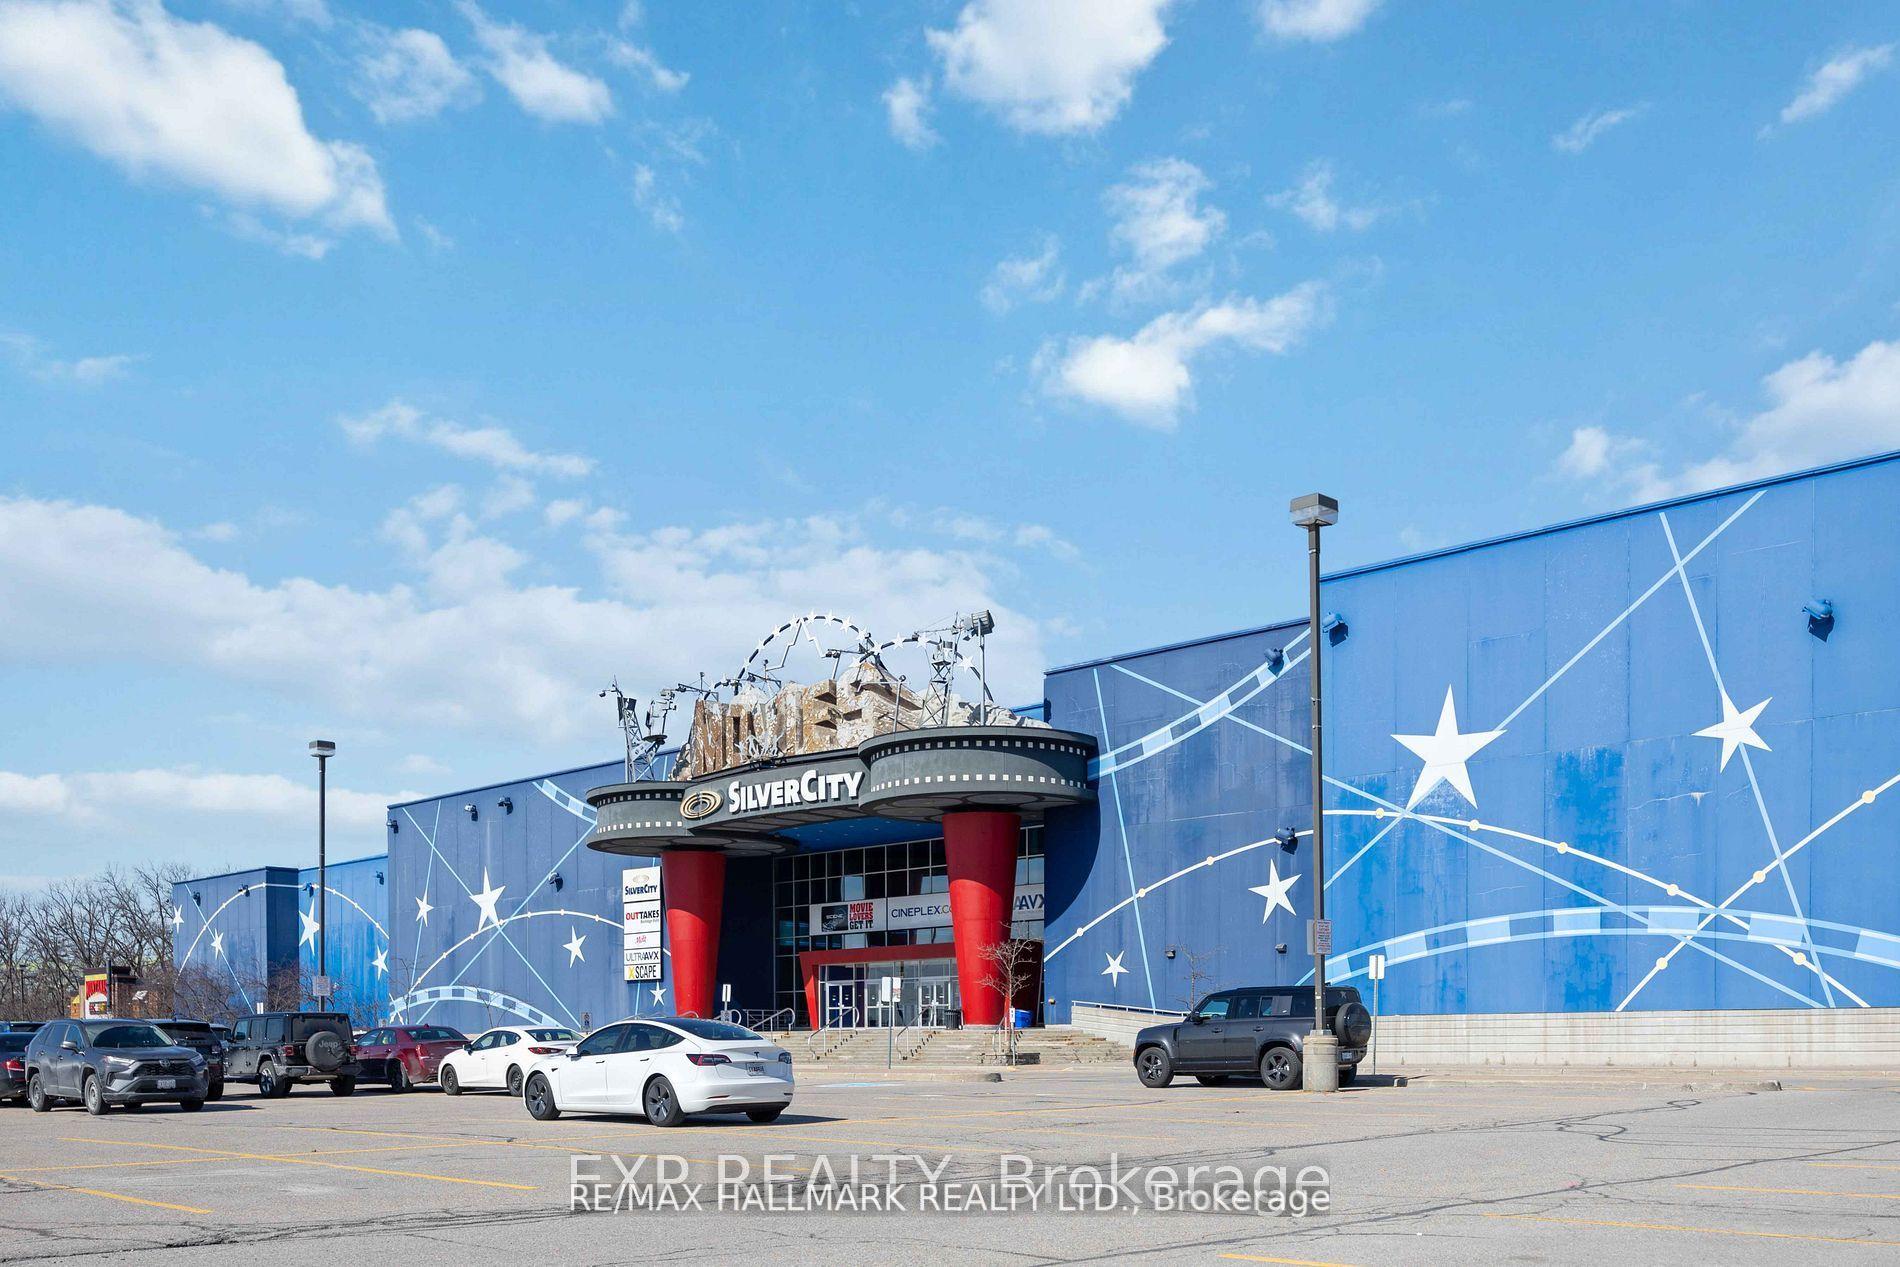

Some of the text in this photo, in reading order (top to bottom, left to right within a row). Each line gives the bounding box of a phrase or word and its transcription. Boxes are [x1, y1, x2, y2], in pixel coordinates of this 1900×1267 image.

[850, 902, 874, 913] MOVIE
[626, 910, 659, 920] OUTTAKES
[850, 912, 874, 921] LOVERS
[850, 920, 874, 930] GET IT
